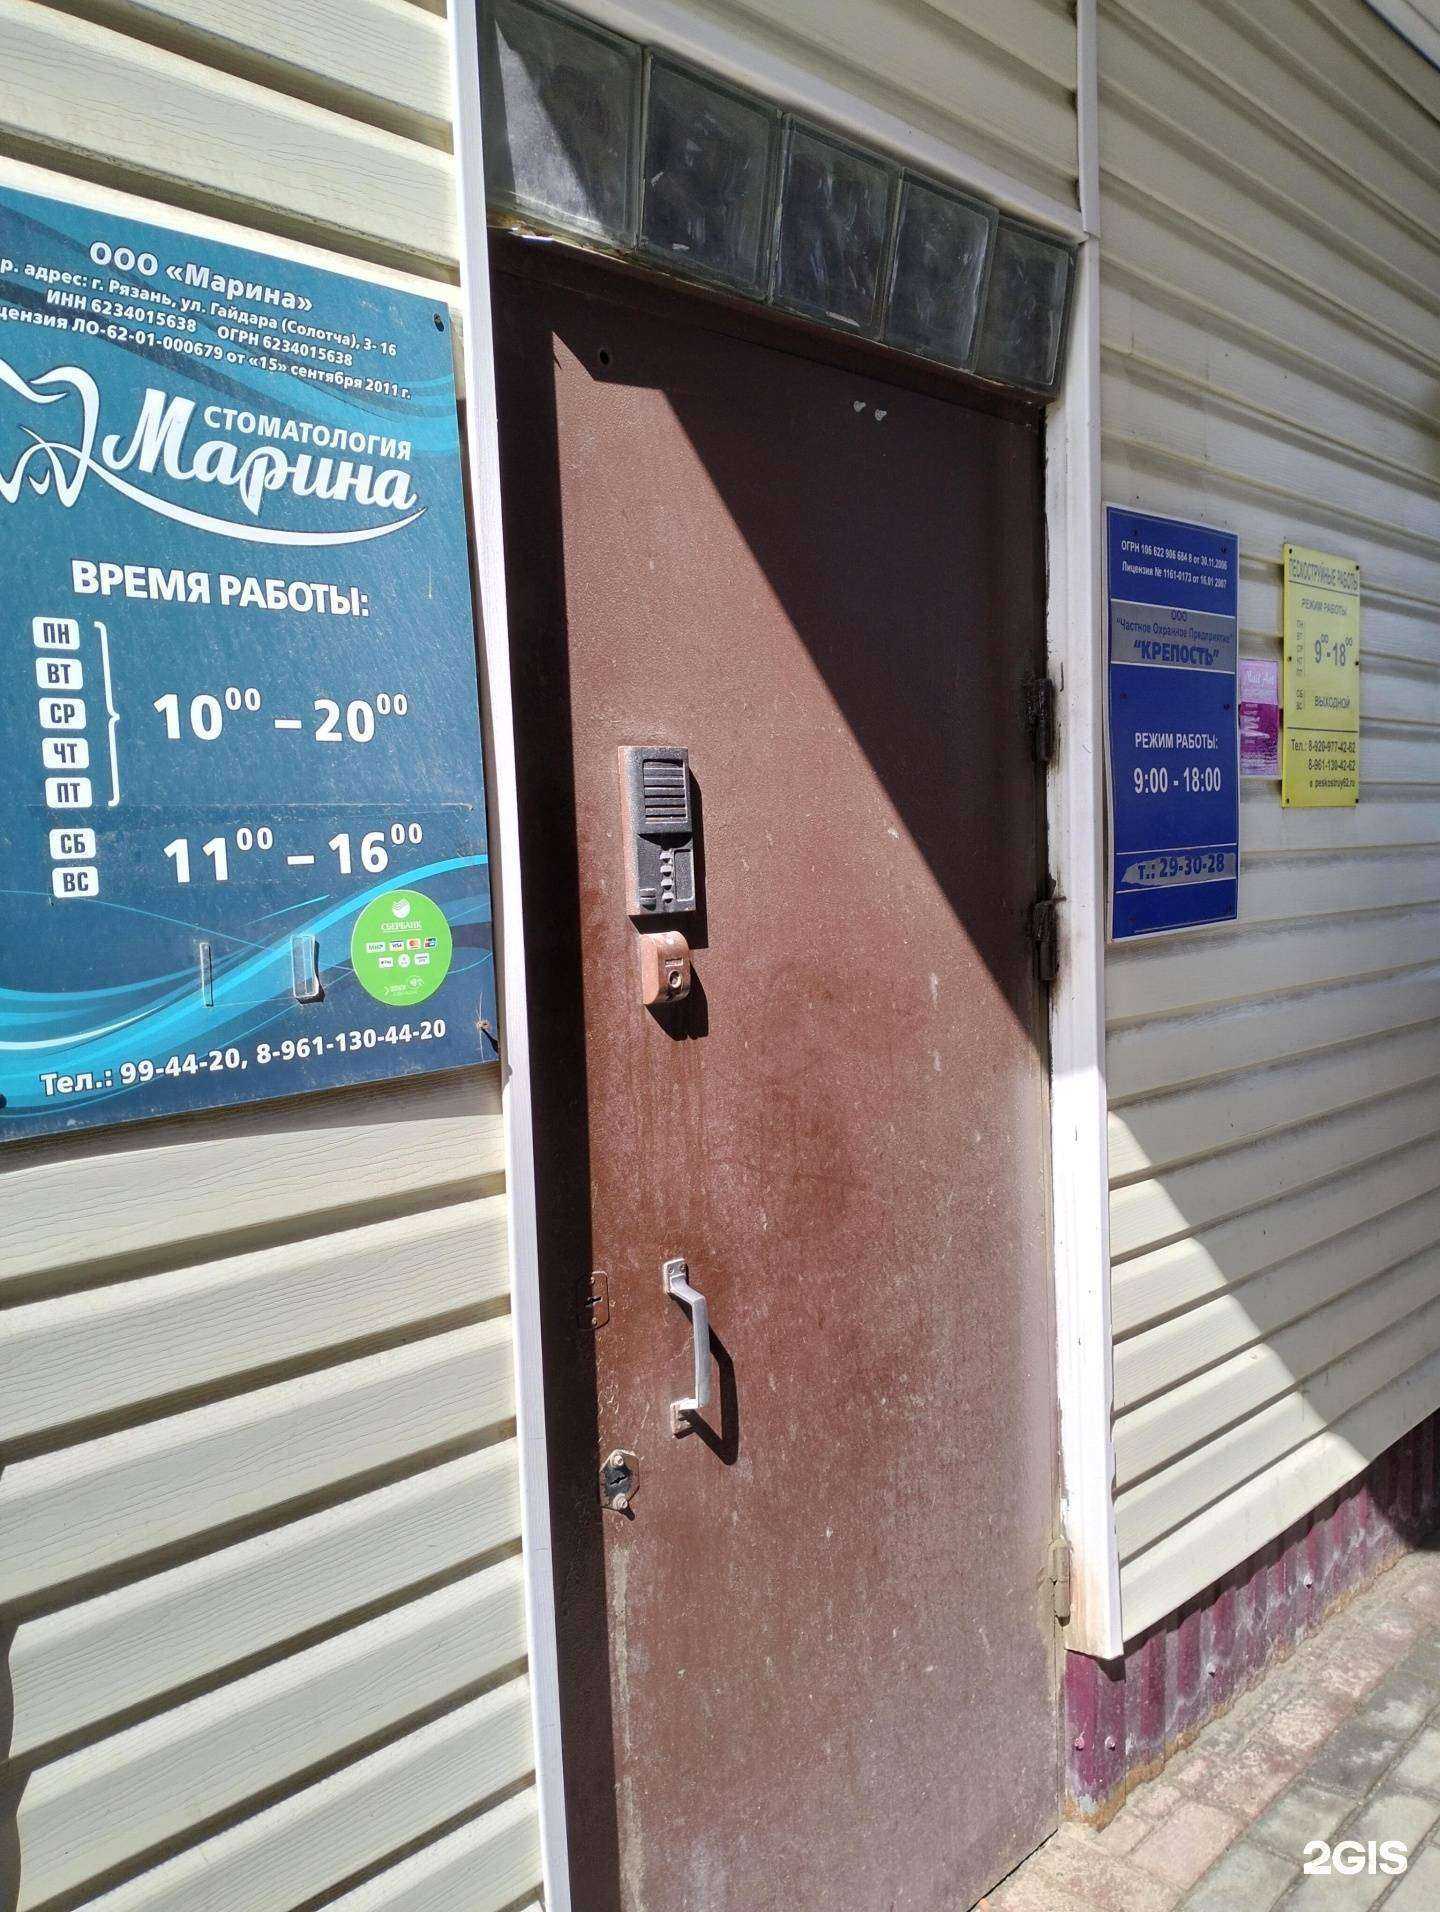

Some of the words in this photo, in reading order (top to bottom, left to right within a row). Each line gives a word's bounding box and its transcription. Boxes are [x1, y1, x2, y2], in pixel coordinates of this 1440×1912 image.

[90, 242, 158, 276] ООО
[166, 263, 313, 312] «Марина»
[24, 263, 87, 288] адрес:
[91, 278, 103, 291] г.
[109, 279, 177, 308] Рязань,
[181, 297, 206, 313] ул.
[210, 302, 278, 330] Гайдара
[281, 318, 360, 350] (Солотча),
[46, 289, 87, 310] ИНН
[90, 298, 197, 333] 6234015638
[217, 325, 259, 346] ОГРН
[262, 335, 353, 367] 6234015638
[71, 317, 223, 360] ЛО-62-01-000679
[226, 350, 246, 365] от
[248, 355, 287, 372] «15»
[290, 363, 363, 390] сентября
[365, 378, 399, 397] 2011
[401, 388, 412, 400] г.
[203, 404, 412, 461] СТОМАТОЛОГИЯ
[101, 388, 418, 516] Марина
[1121, 540, 1140, 553] ОГРН
[1122, 560, 1153, 575] Лицензия
[71, 559, 209, 604] ВРЕМЯ
[219, 574, 370, 617] РАБОТЫ:
[1170, 609, 1188, 622] ООО
[42, 623, 70, 645] ПН
[1153, 622, 1188, 638] Охранное
[47, 663, 72, 684] ВТ
[50, 702, 76, 724] СР
[1135, 732, 1174, 749] РЕЖИМ
[1176, 734, 1218, 749] РАБОТЫ:
[53, 743, 78, 764] ЧТ
[1133, 767, 1168, 794] 9:00
[1183, 767, 1221, 793] 18:00
[56, 782, 82, 803] ПТ
[59, 833, 86, 855] СБ
[1158, 853, 1225, 878] 29-30-28
[63, 872, 89, 893] ВС
[40, 1068, 113, 1096] Тел.:
[120, 1047, 249, 1085] 99-44-20,
[256, 1019, 446, 1065] 8-961-130-44-20
